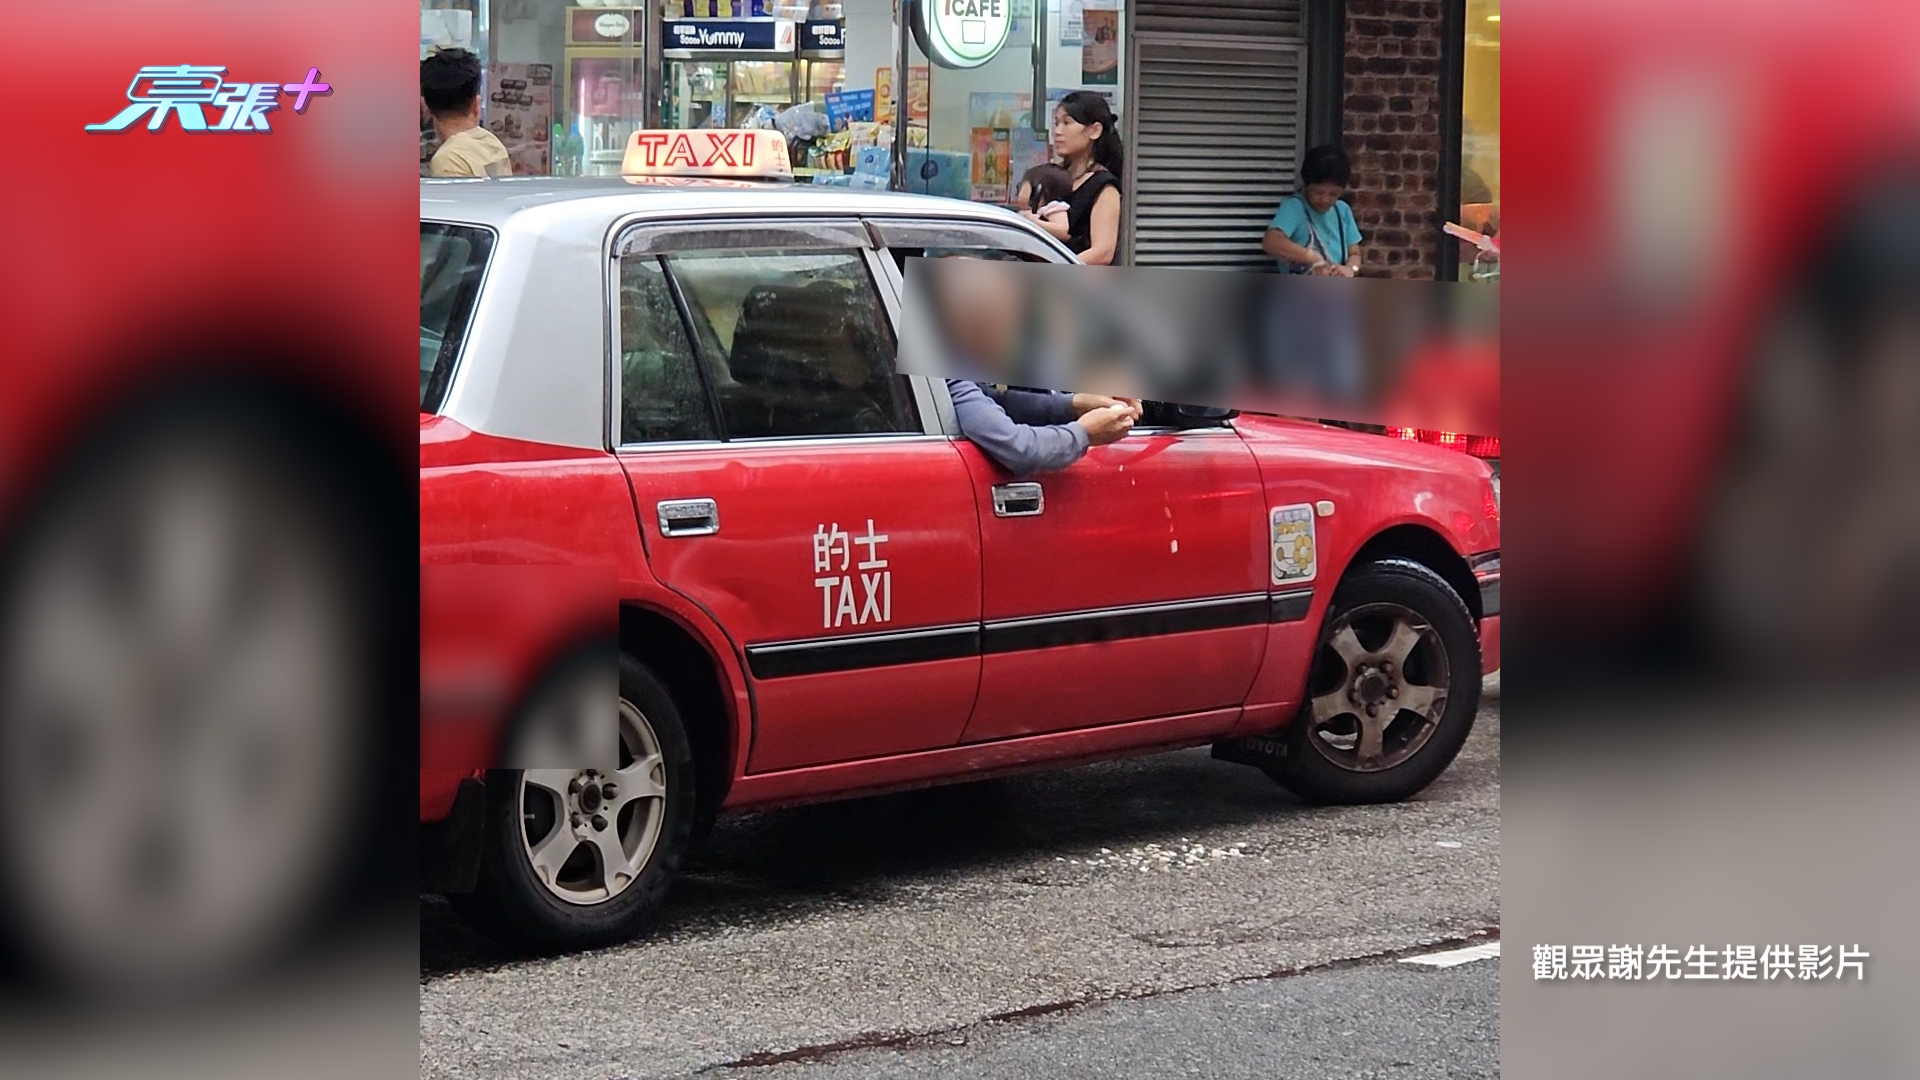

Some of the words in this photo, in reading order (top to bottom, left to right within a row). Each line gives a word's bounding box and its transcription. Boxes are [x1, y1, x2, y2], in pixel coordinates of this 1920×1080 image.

[699, 28, 745, 49] Yummy
[638, 133, 755, 167] TAXI
[771, 139, 785, 167] 的士
[814, 519, 889, 572] 的士
[814, 571, 891, 628] TAXI
[1239, 738, 1288, 757] TOYOTA
